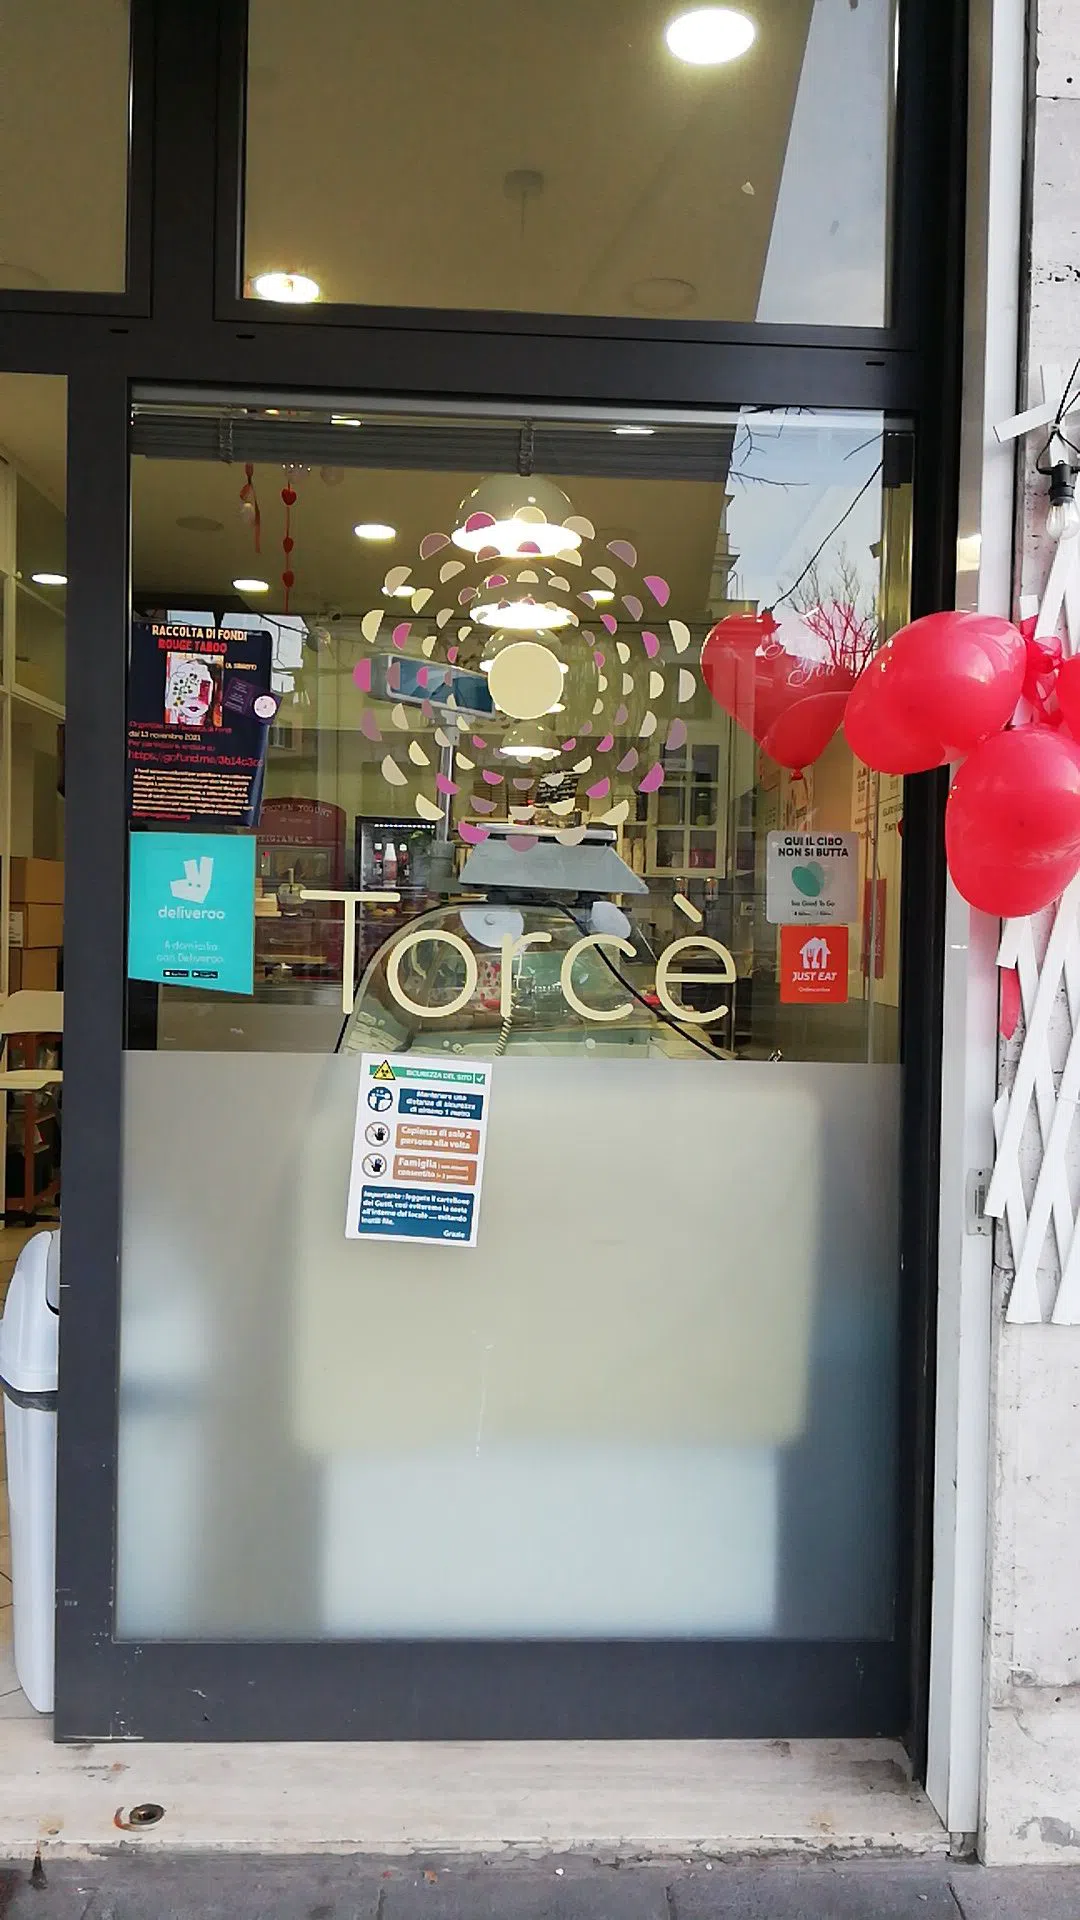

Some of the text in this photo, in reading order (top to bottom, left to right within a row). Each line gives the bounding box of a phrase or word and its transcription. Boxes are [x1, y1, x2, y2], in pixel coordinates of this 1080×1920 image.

[152, 625, 248, 642] RACCOLTA DI FONDI
[158, 639, 228, 653] ROUGE TABOO
[784, 837, 843, 846] QUI IL CIBO
[778, 848, 849, 857] NON SI BUTTA
[158, 905, 225, 920] deliveroo
[299, 889, 737, 1023] Torcè
[792, 971, 838, 982] JUST EAT
[406, 1070, 442, 1079] SICUREZZA
[417, 1090, 452, 1100] Mantenere
[406, 1098, 434, 1106] distanza
[443, 1101, 476, 1110] sicurezza
[445, 1108, 449, 1116] 1
[401, 1126, 438, 1138] Capienza
[439, 1129, 448, 1137] di
[448, 1129, 466, 1138] solo
[400, 1136, 471, 1149] persone alla volta
[398, 1157, 437, 1170] Famiglia
[397, 1169, 436, 1178] consentito
[436, 1195, 470, 1205] cartellone
[409, 1203, 442, 1211] eviteremo
[443, 1204, 449, 1212] la
[396, 1210, 408, 1218] del
[443, 1229, 466, 1238] Grazie
